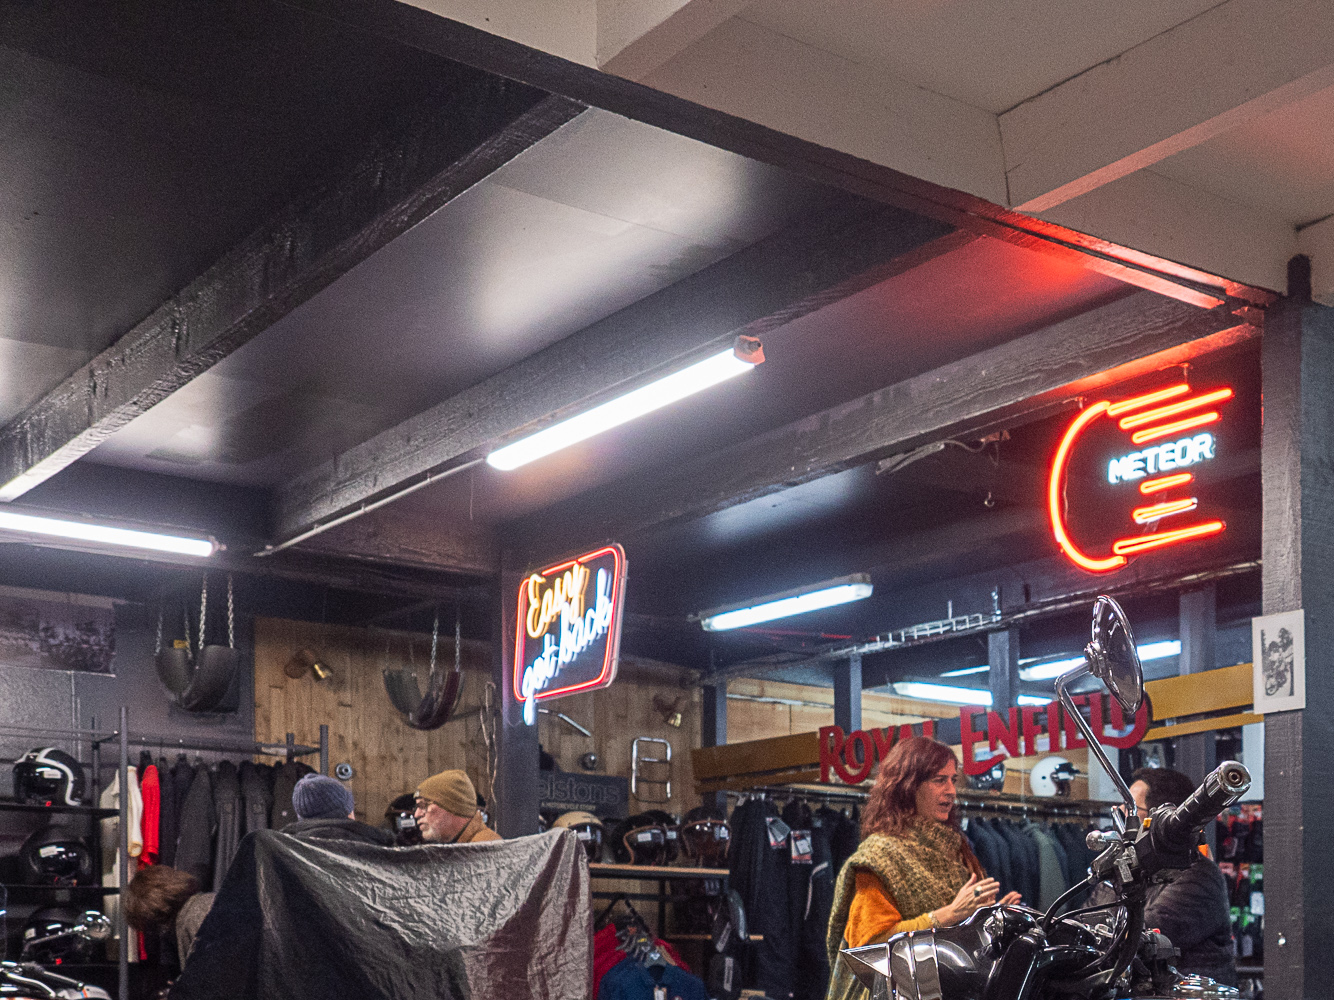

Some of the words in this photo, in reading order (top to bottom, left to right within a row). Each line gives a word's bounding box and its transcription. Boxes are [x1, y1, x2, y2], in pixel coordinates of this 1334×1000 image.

[1107, 433, 1214, 484] METEOR
[526, 564, 589, 639] Easy
[558, 568, 614, 668] back
[819, 719, 935, 785] ROY
